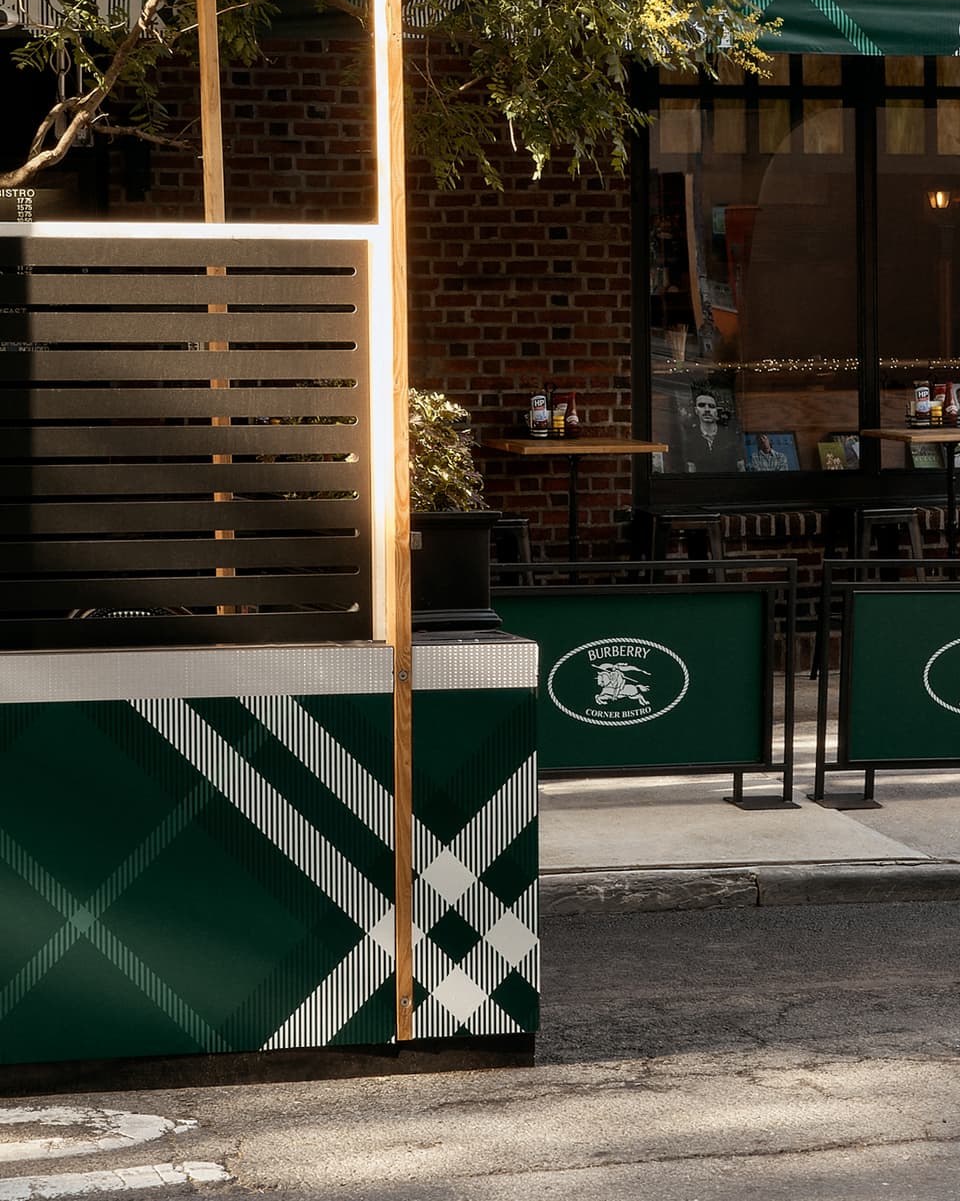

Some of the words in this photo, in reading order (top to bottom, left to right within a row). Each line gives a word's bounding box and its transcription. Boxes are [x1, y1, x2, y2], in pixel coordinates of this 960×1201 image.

[0, 188, 35, 197] ISTRO
[919, 390, 929, 398] HP
[534, 399, 544, 407] HP
[587, 645, 651, 661] BURBERRY
[585, 708, 620, 719] CORNER
[622, 706, 652, 718] BISTRO
